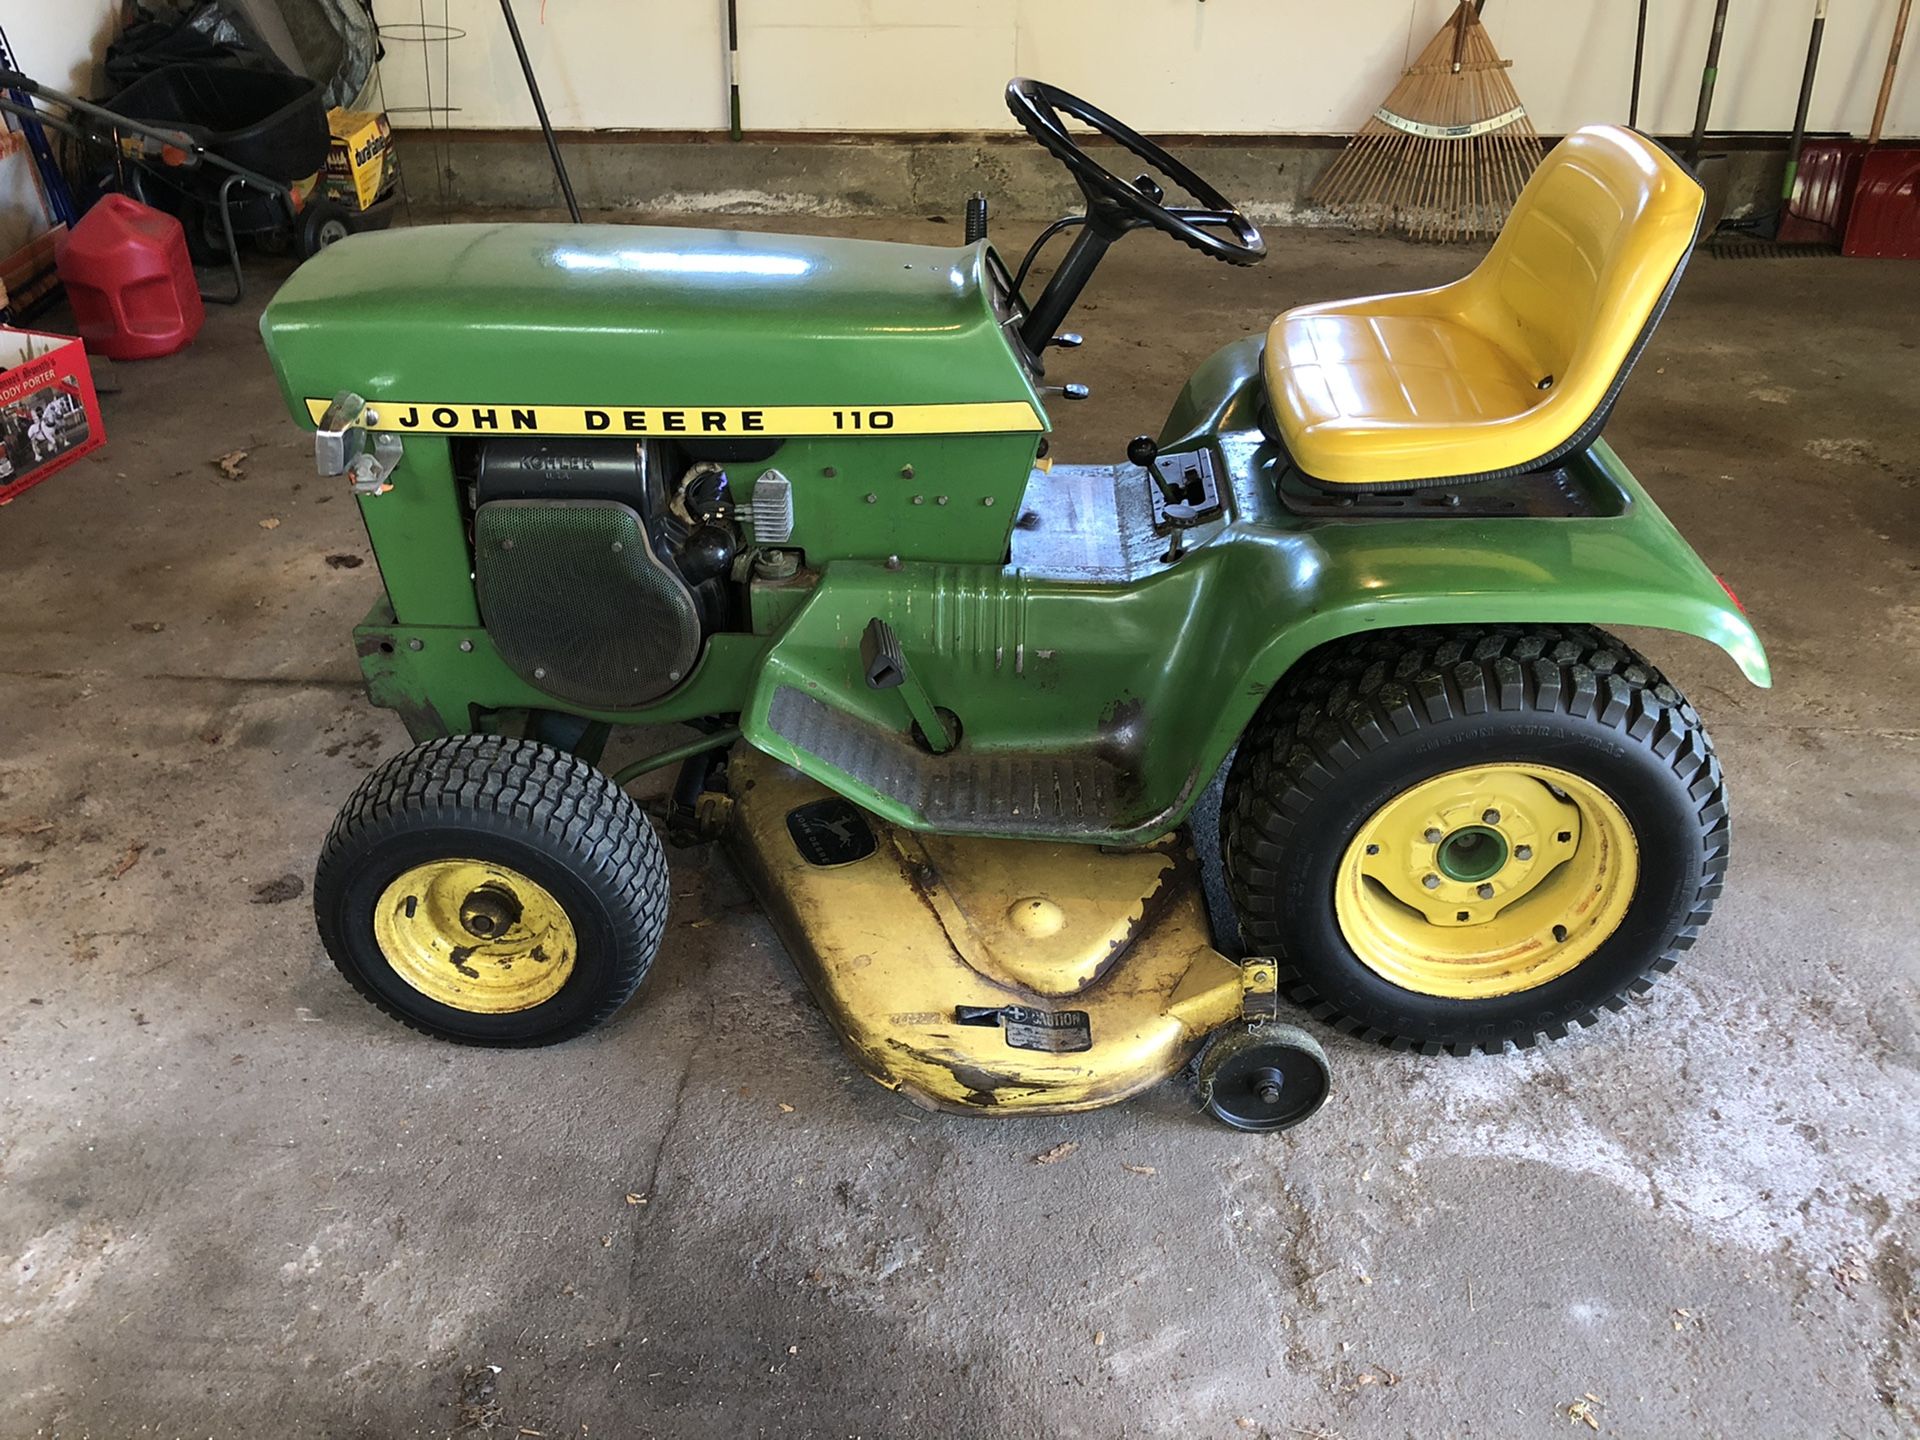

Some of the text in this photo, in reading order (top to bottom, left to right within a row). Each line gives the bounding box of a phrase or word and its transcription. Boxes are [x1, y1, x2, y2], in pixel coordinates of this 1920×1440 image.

[23, 369, 56, 391] PORTER
[399, 407, 894, 432] JOHN DEERE 110
[520, 456, 595, 471] KOHLER
